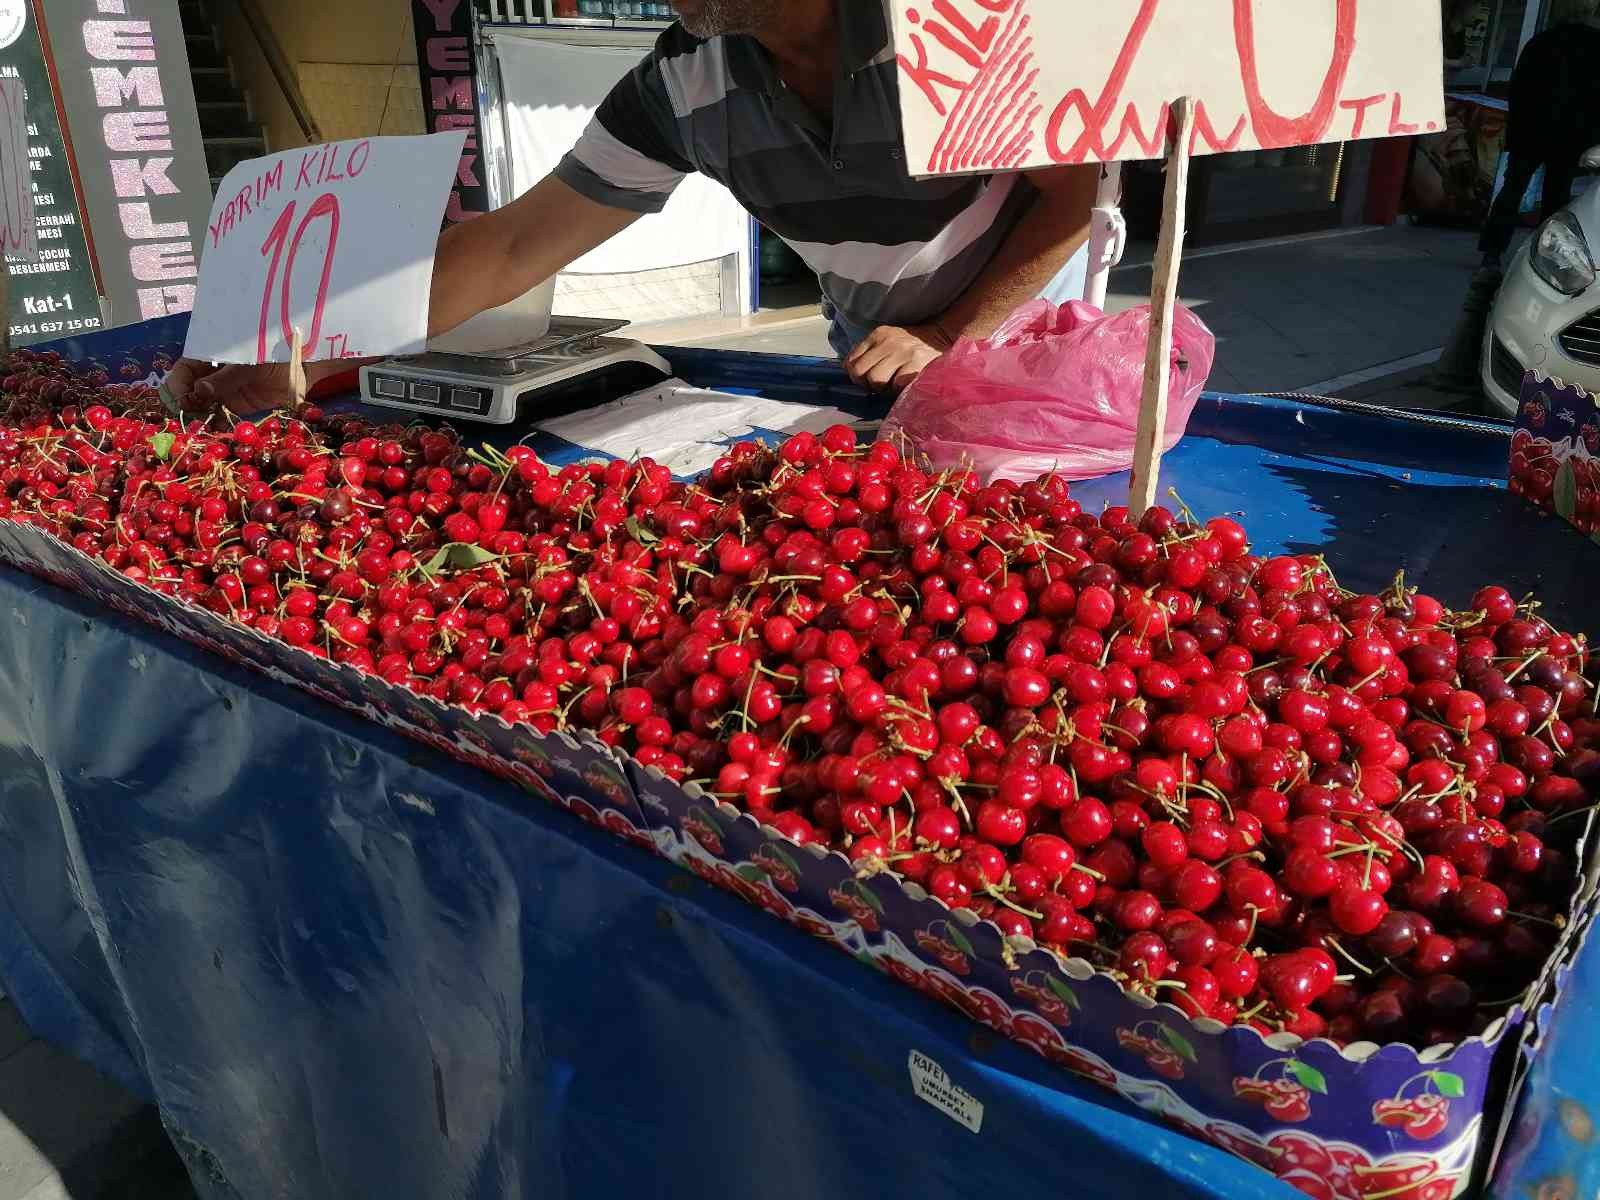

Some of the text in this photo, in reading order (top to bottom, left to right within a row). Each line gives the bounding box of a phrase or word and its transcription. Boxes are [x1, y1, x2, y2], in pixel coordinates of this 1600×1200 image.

[209, 138, 370, 248] YARIM KİLO
[9, 259, 70, 275] BESLENMESİ
[256, 193, 340, 364] 10
[24, 294, 73, 315] Kat-1
[41, 321, 63, 333] 637
[66, 319, 82, 330] 15
[84, 317, 101, 328] 02
